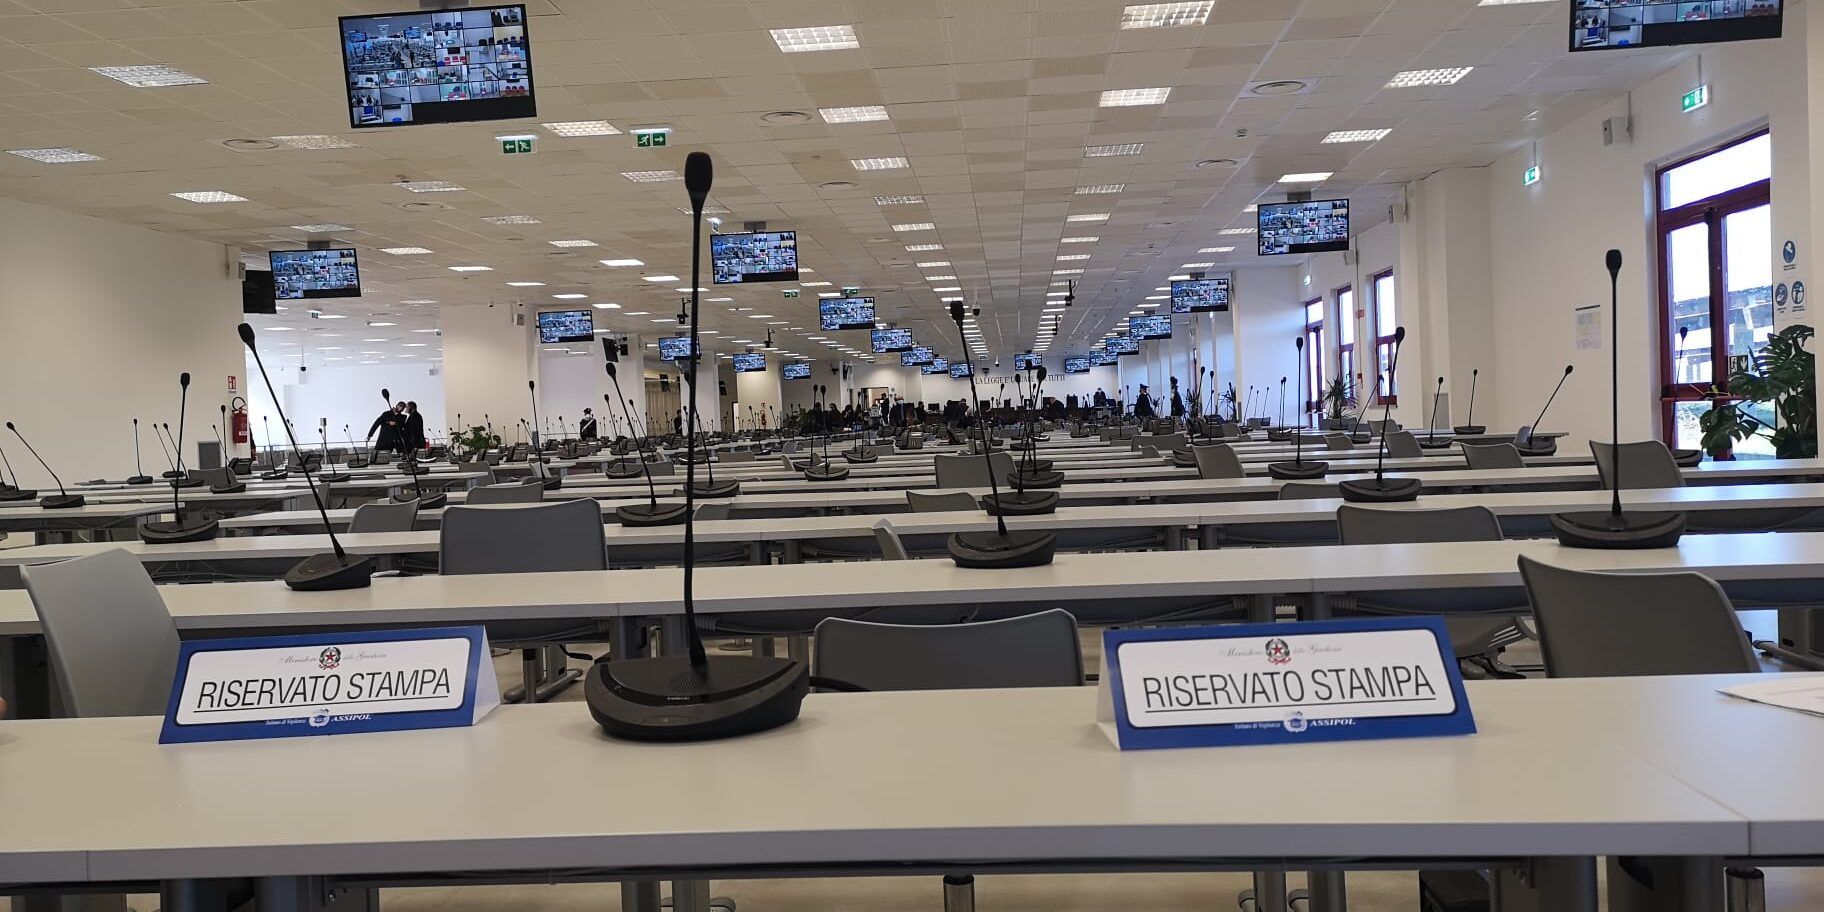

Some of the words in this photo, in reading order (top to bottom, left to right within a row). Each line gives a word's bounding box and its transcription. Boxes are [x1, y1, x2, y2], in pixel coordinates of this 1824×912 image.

[197, 674, 341, 708] RISERVATO
[346, 668, 450, 699] STAMPA
[1143, 669, 1305, 708] RISERVATO
[1312, 664, 1436, 700] STAMPA
[331, 713, 372, 722] ASSIPOL
[1310, 718, 1357, 727] ASSIPOL
